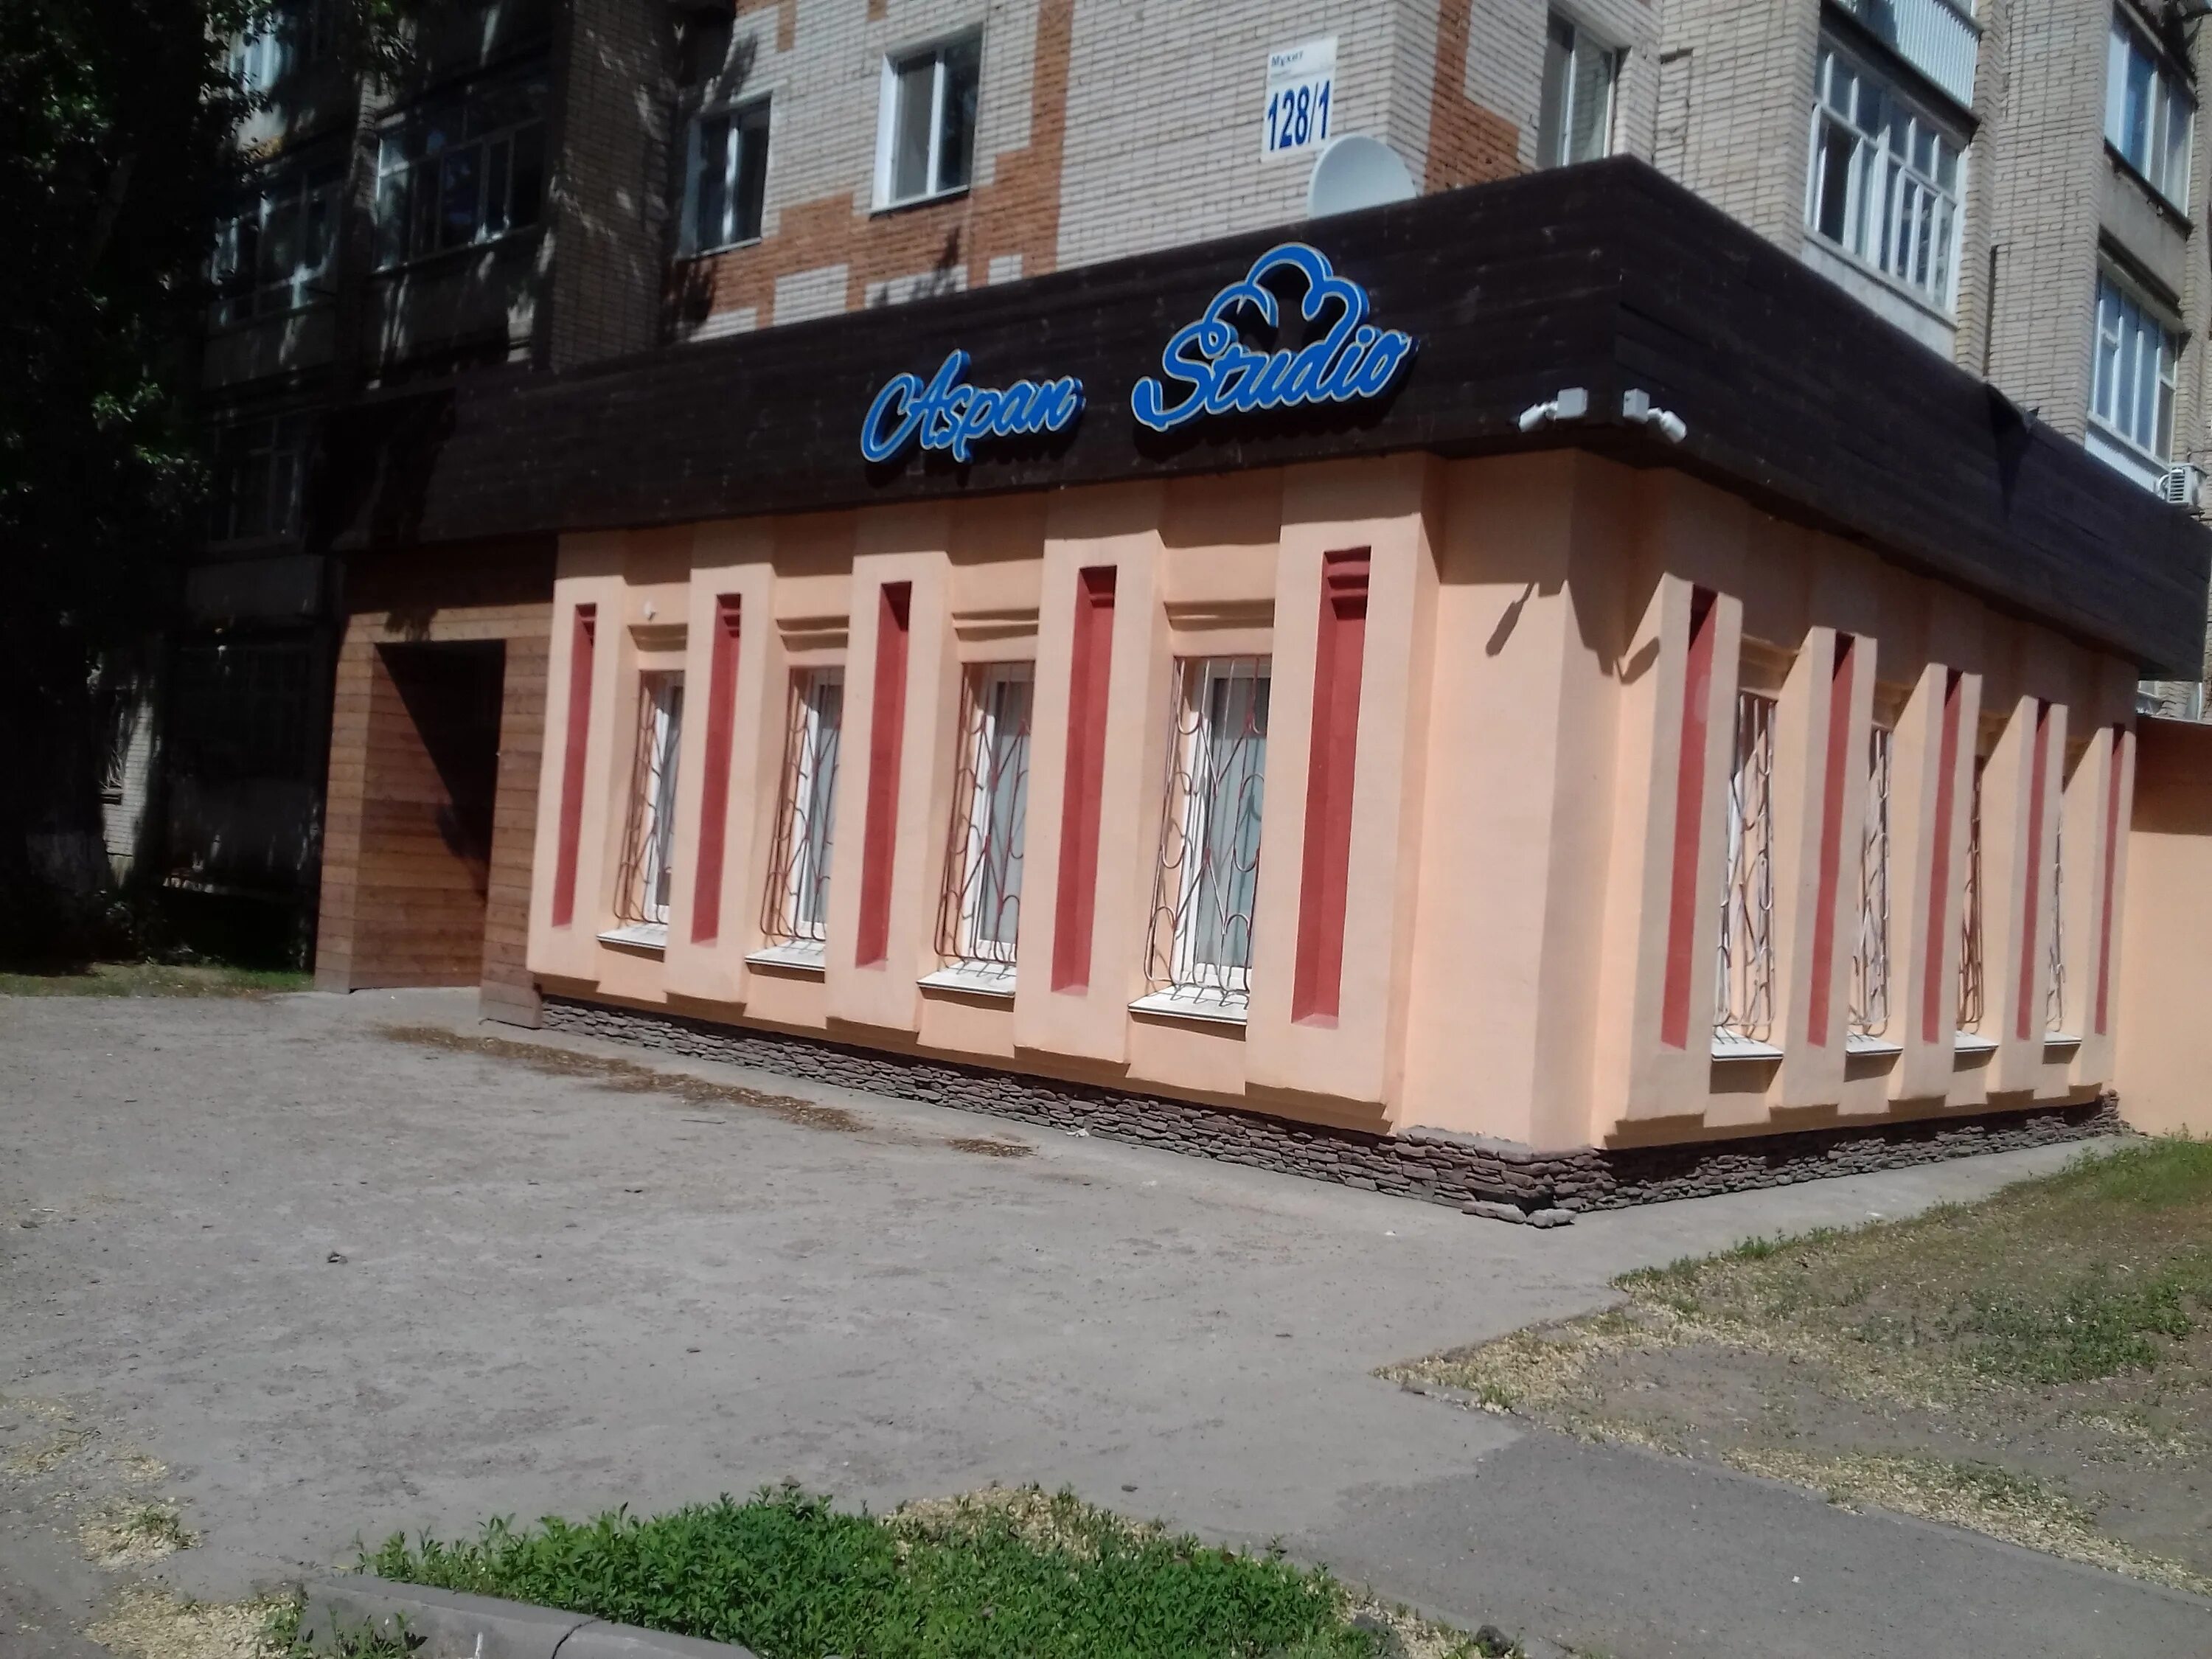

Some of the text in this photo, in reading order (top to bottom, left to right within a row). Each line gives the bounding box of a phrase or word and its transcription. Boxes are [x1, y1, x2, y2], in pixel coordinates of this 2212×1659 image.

[1267, 79, 1330, 151] 128/1
[860, 274, 1416, 464] Aspan Studio
